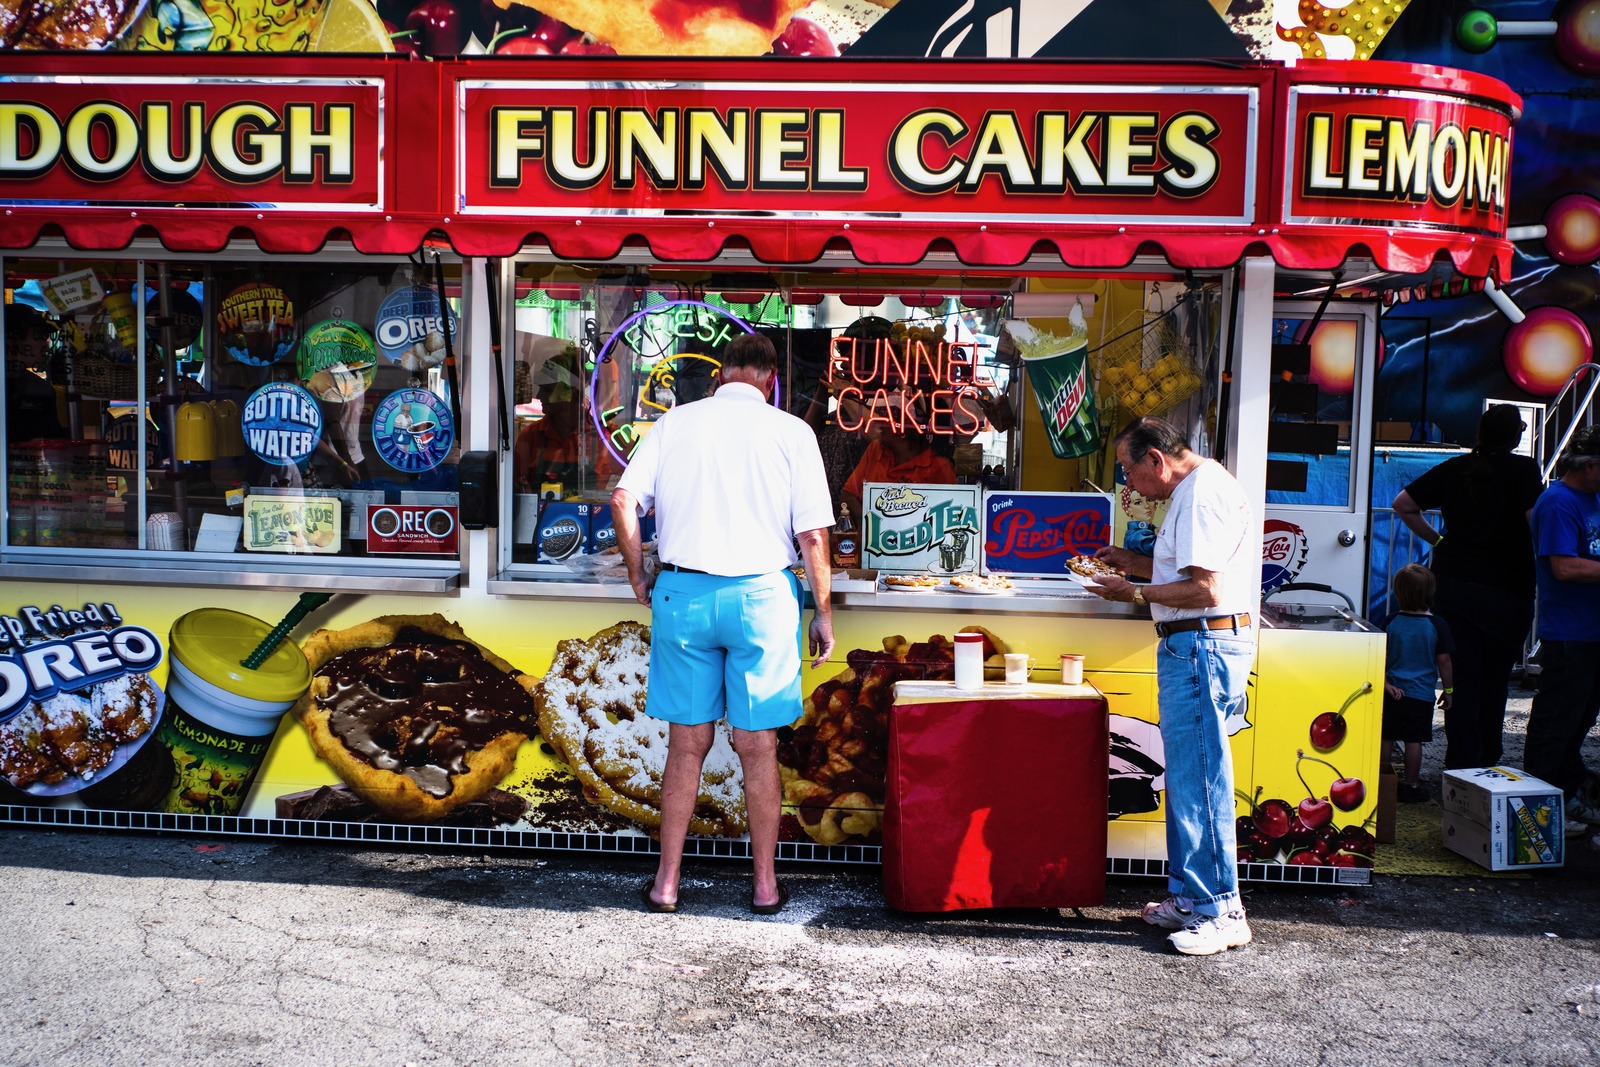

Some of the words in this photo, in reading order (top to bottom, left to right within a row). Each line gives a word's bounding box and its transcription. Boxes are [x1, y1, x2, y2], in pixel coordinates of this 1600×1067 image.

[0, 100, 355, 184] DOUGH
[490, 106, 869, 192] FUNNEL
[887, 107, 1221, 199] CAKES
[1302, 111, 1510, 215] LEMONA
[222, 289, 261, 309] SOUTHERN
[261, 288, 284, 301] STYLE
[383, 305, 408, 318] DEEP
[413, 301, 441, 315] FRIE
[217, 300, 264, 334] SWEET
[266, 300, 294, 329] TEA
[302, 337, 376, 381] Lemonade
[828, 336, 995, 388] FUNNEL
[243, 392, 319, 429] BOTTLED
[259, 385, 282, 396] SUPER
[296, 389, 313, 405] COLD
[836, 386, 979, 435] CAKES
[375, 397, 399, 434] ICE
[400, 391, 450, 427] COLD
[105, 421, 159, 447] BOTTED
[248, 428, 313, 460] WATER
[377, 429, 451, 470] DRINKS
[107, 448, 155, 470] WATR
[43, 482, 72, 491] COCOA
[272, 504, 284, 513] Cold
[577, 505, 588, 513] 10
[884, 495, 929, 512] Brewed
[991, 498, 1014, 512] Drink
[248, 505, 334, 547] LEMONADE
[371, 507, 455, 539] OREO
[541, 525, 577, 539] OREO
[595, 528, 616, 540] OR
[864, 511, 932, 557] ICED
[924, 498, 980, 552] TEA
[1262, 536, 1291, 561] I-COLA
[173, 714, 246, 753] LEMONADE
